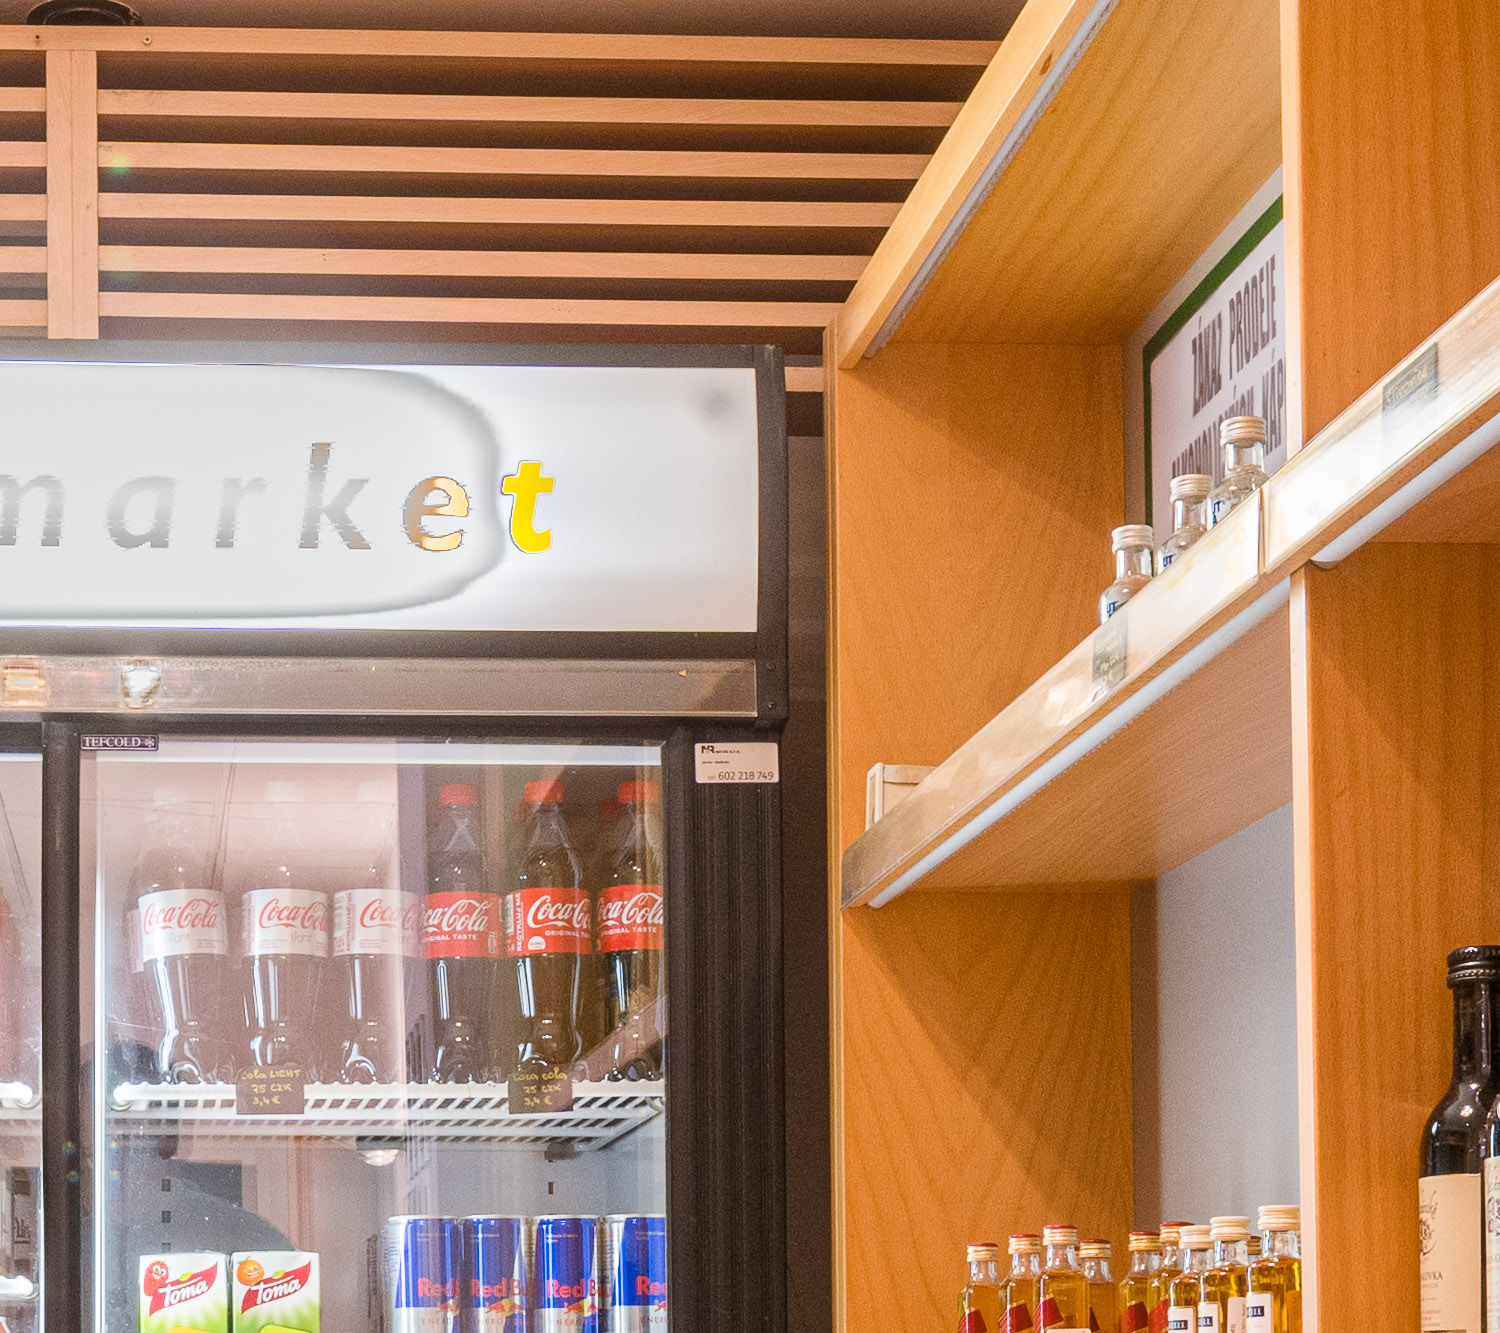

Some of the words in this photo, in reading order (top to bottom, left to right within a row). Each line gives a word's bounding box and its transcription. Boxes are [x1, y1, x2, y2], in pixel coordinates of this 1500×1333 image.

[83, 736, 142, 747] TEFCOLD
[719, 771, 735, 780] 602
[738, 771, 754, 780] 218
[757, 771, 774, 780] 749
[143, 899, 217, 934] Coca-Cola
[162, 1276, 209, 1306] Toma
[254, 1274, 302, 1304] Toma
[547, 1279, 585, 1298] Red
